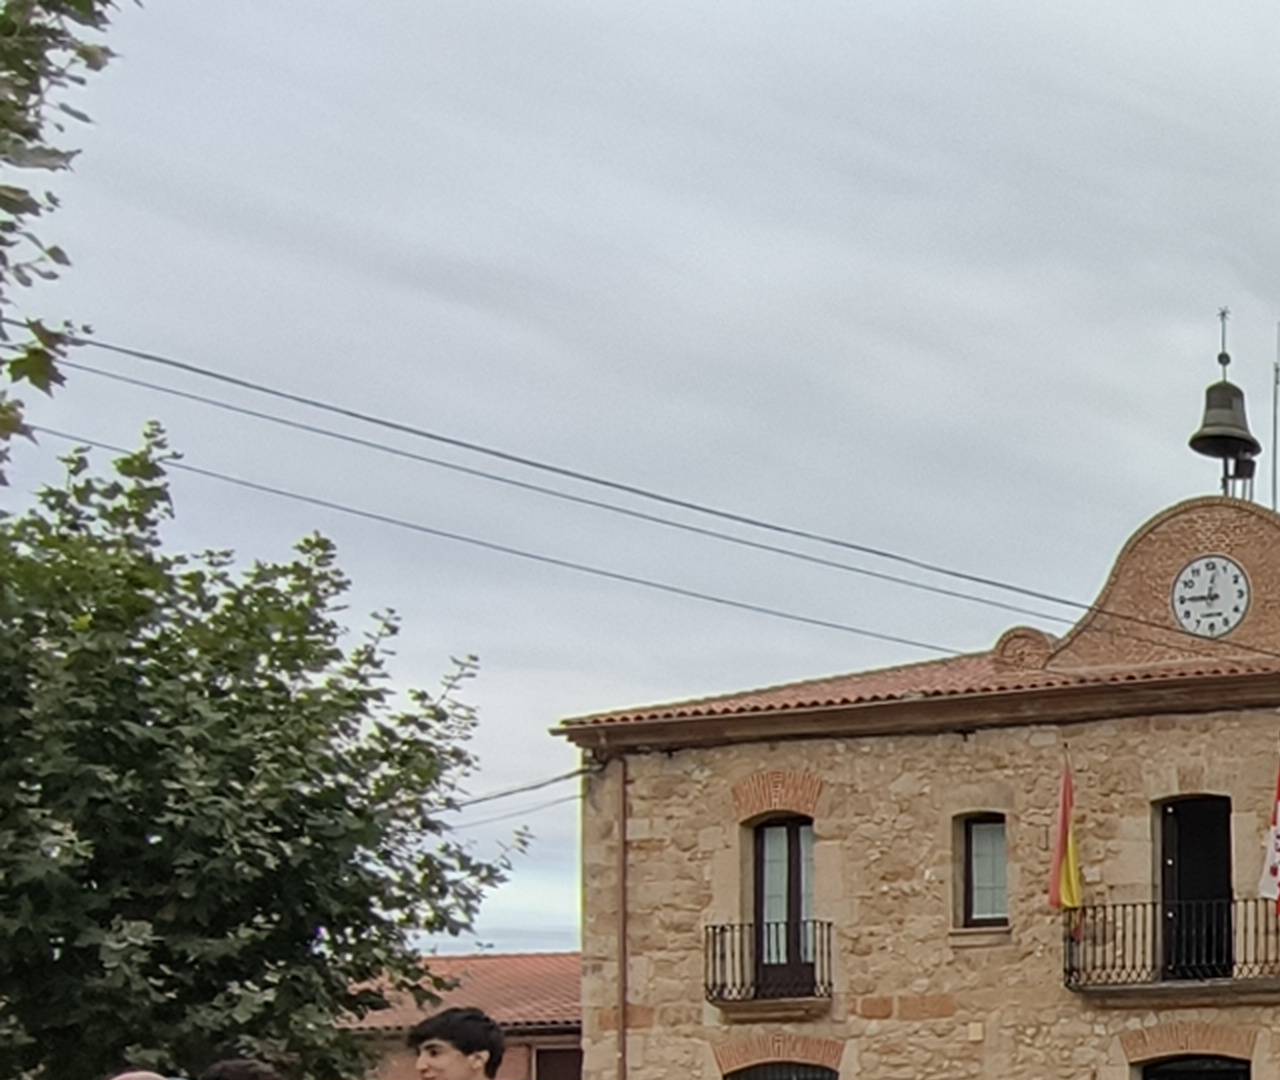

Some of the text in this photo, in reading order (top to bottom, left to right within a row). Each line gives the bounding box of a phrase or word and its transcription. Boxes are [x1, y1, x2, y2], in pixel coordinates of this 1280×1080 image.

[1205, 561, 1216, 571] 12
[1222, 565, 1227, 574] 1
[1183, 579, 1195, 589] 10
[1233, 574, 1239, 584] 2
[1237, 588, 1244, 599] 3
[1184, 610, 1191, 619] 8
[1208, 622, 1215, 632] 6
[1223, 617, 1229, 627] 5
